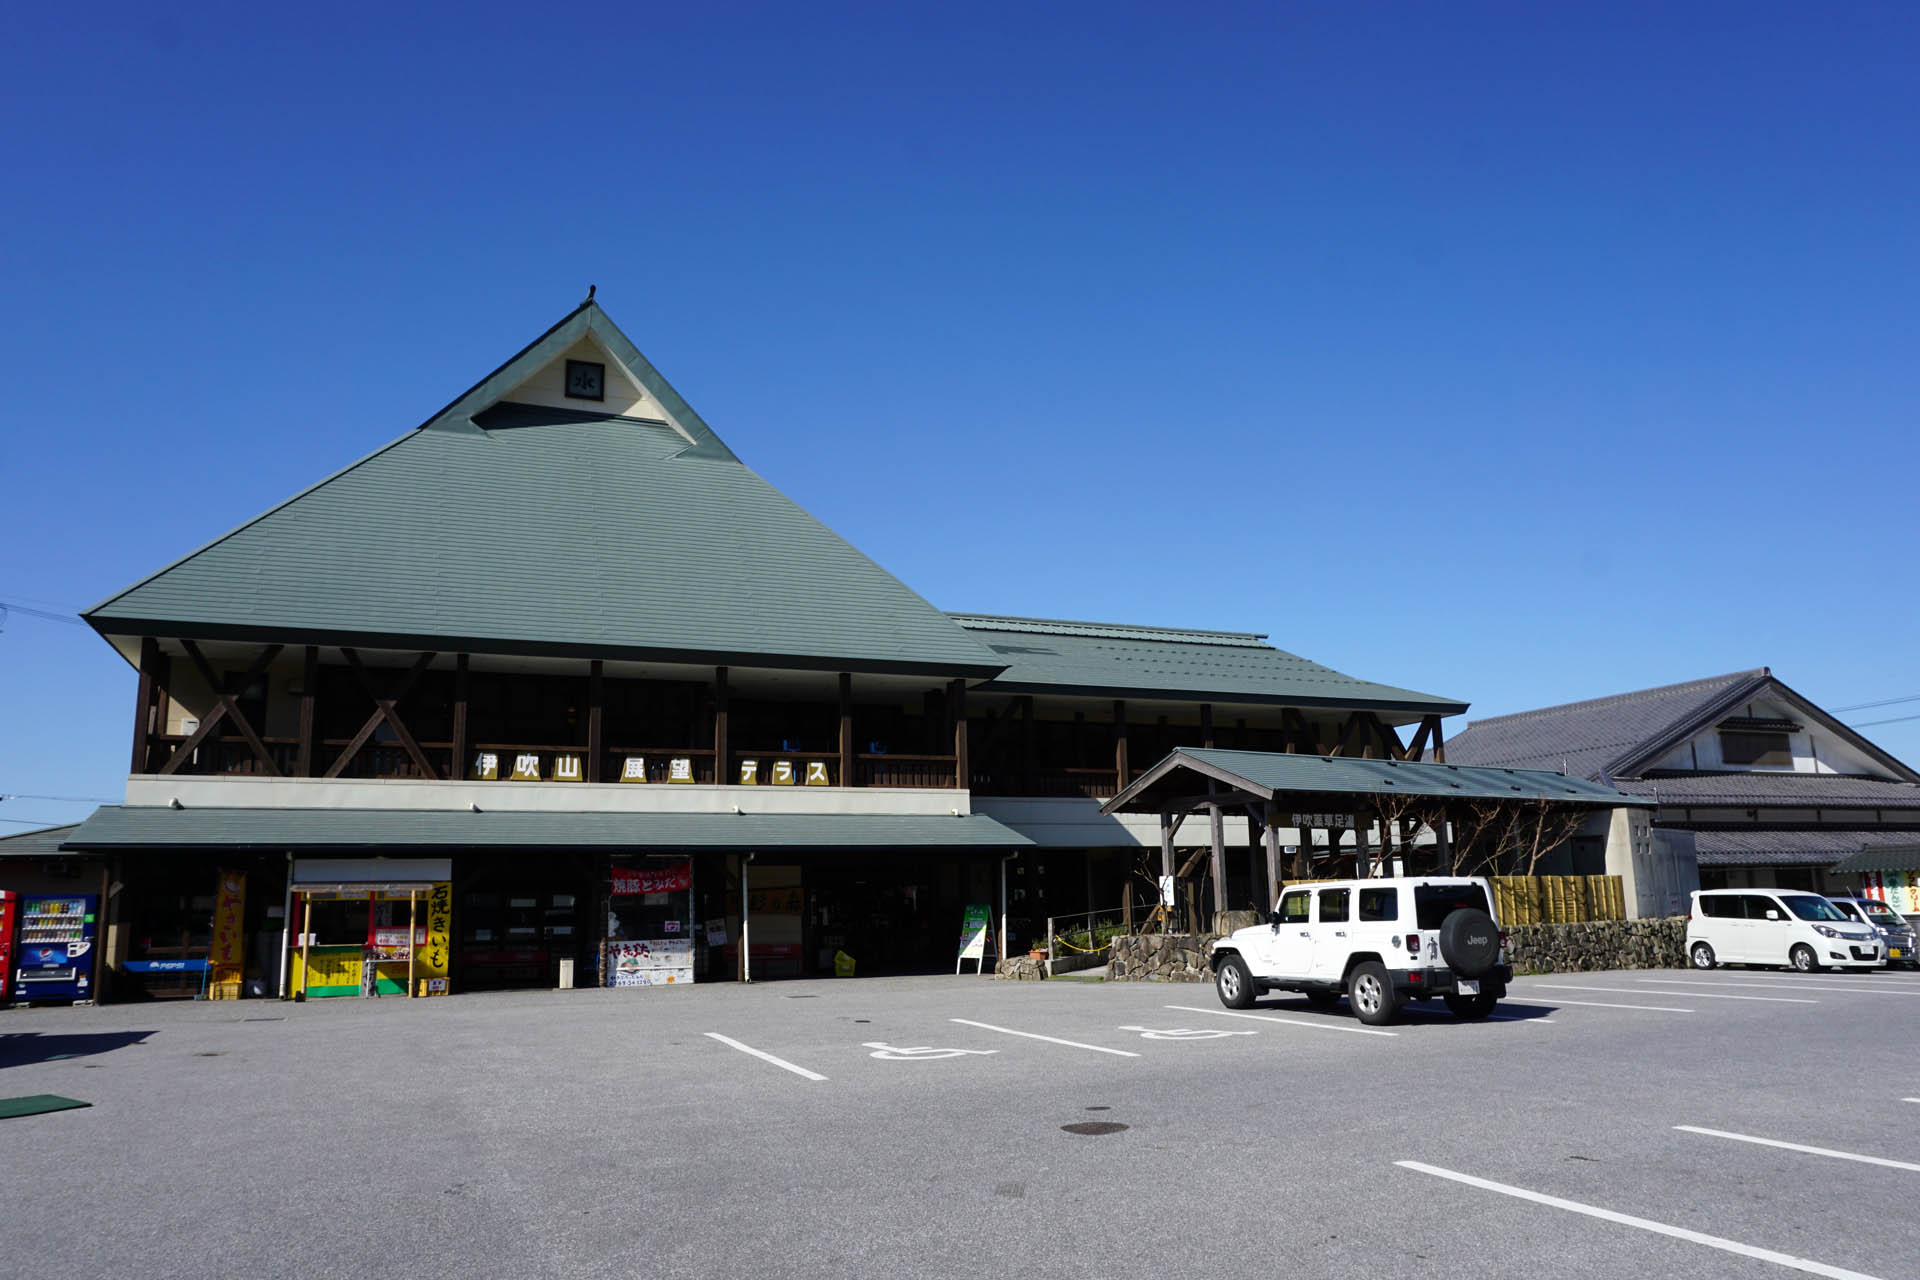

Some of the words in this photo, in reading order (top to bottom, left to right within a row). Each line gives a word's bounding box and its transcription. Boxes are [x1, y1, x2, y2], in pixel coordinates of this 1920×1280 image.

[476, 753, 578, 777] 伊吹山
[624, 757, 691, 780] 展望
[741, 760, 825, 781] テラス
[430, 885, 450, 968] 石焼きいも
[608, 943, 650, 959] やきぶた
[1467, 934, 1488, 946] Jeep
